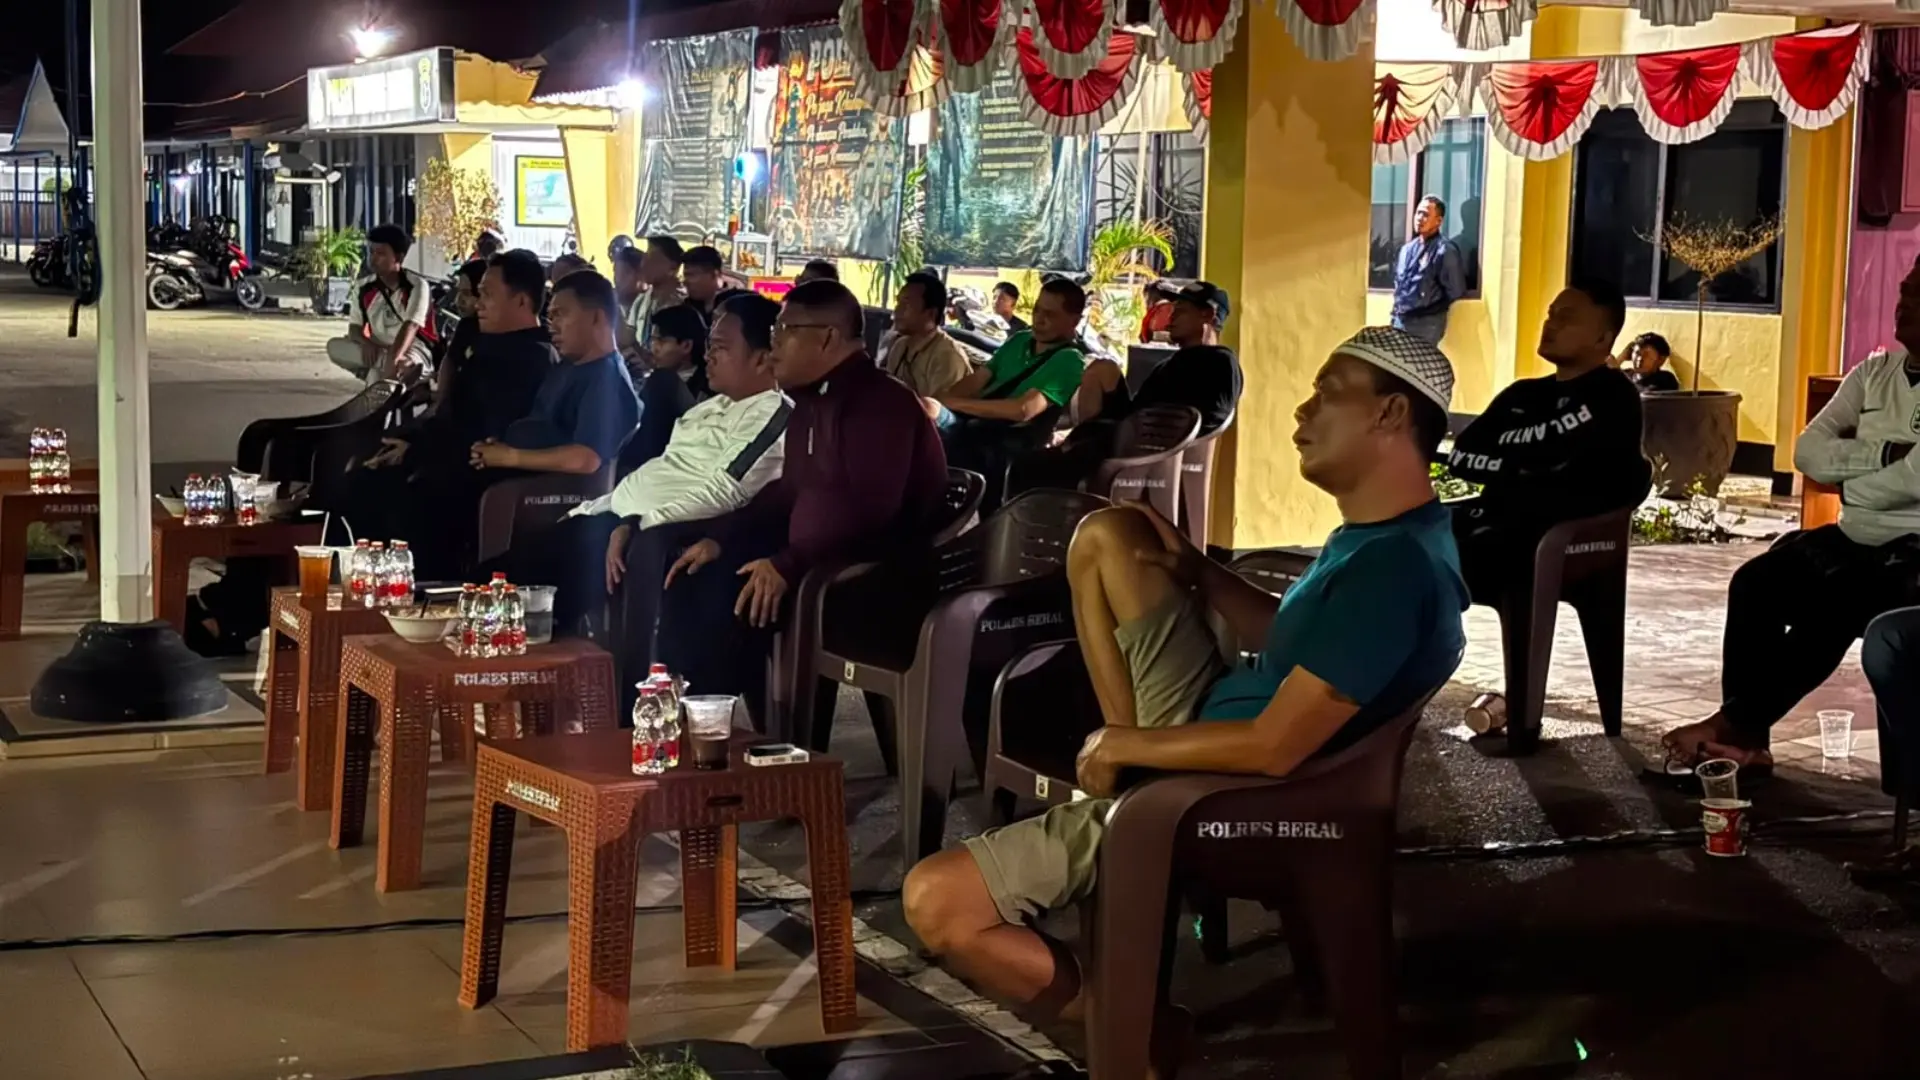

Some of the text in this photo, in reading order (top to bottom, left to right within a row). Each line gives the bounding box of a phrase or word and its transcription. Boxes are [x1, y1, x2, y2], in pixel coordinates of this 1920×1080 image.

[980, 615, 1026, 633] POLRES
[454, 670, 558, 686] POLRES BERAU
[1197, 820, 1344, 839] POLRES BERAU
